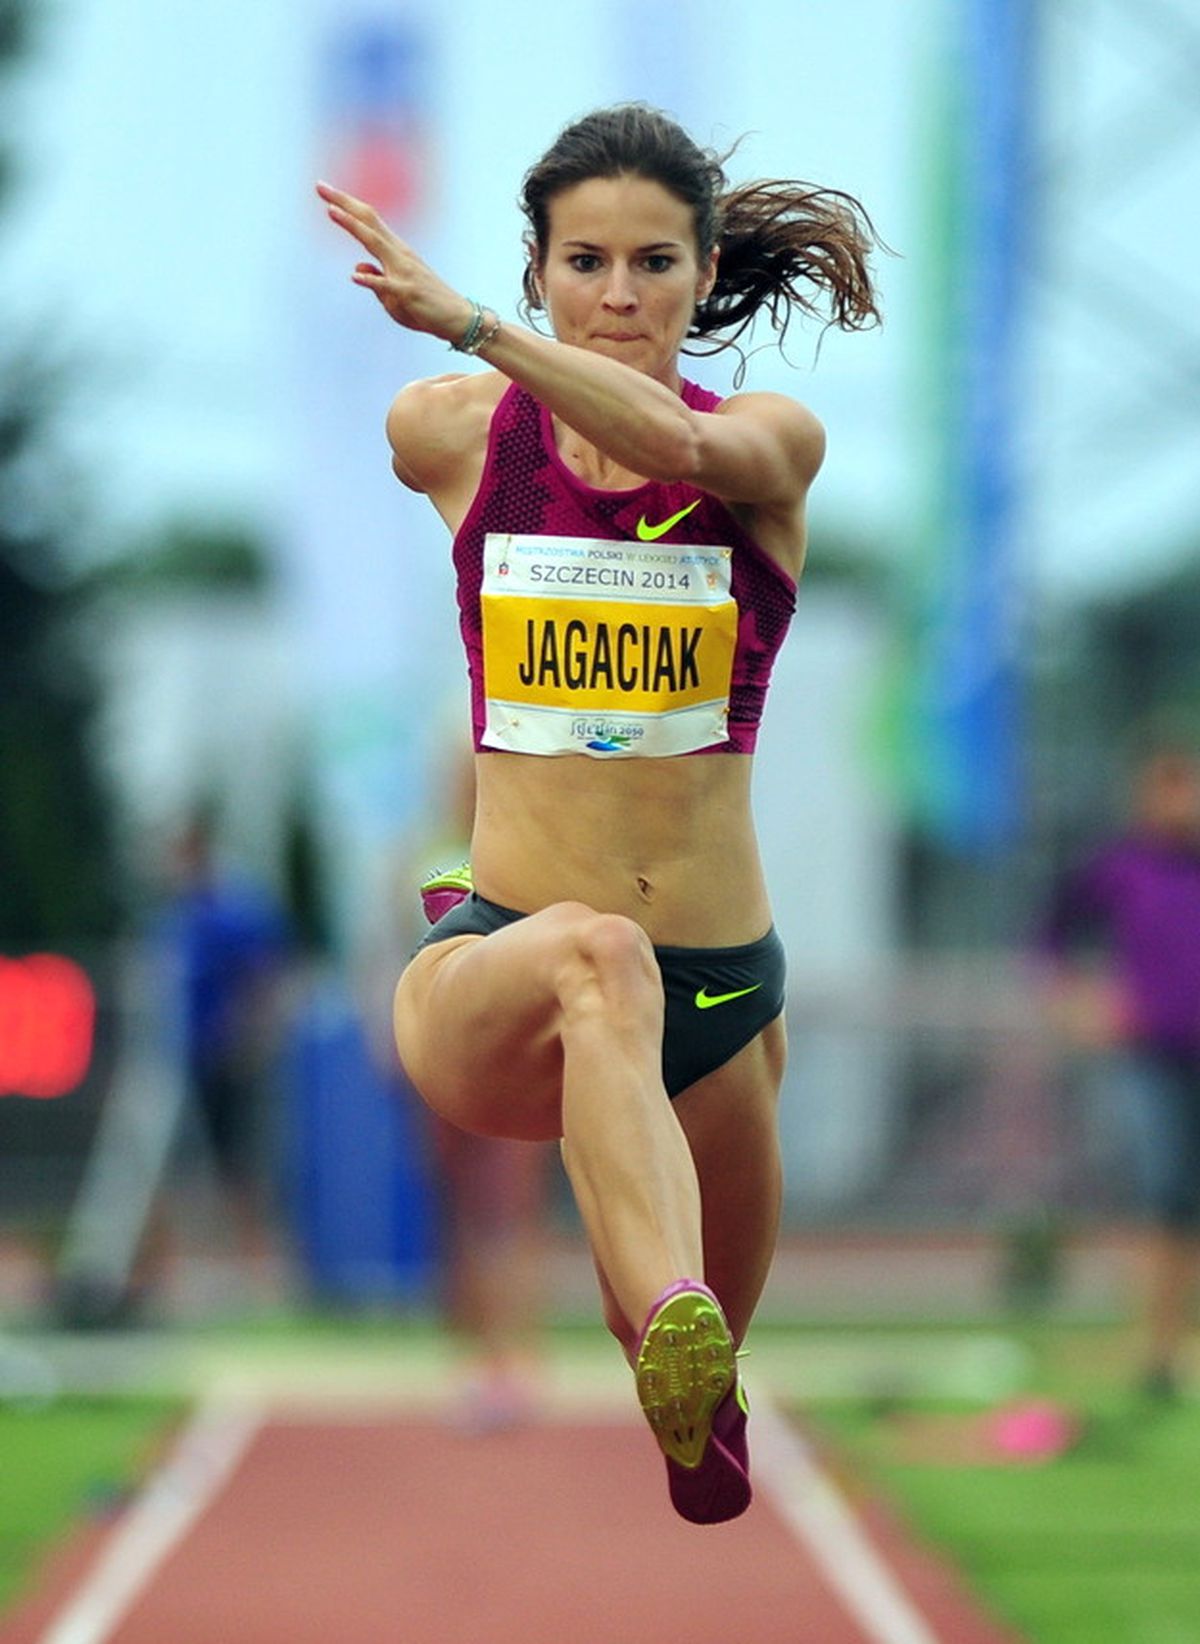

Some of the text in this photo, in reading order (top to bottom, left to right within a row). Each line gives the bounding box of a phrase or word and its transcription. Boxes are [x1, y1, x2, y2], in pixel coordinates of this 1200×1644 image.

[587, 550, 624, 561] POLSKI
[530, 564, 690, 590] SZCZECIN 2014
[519, 619, 703, 692] JAGACIAK
